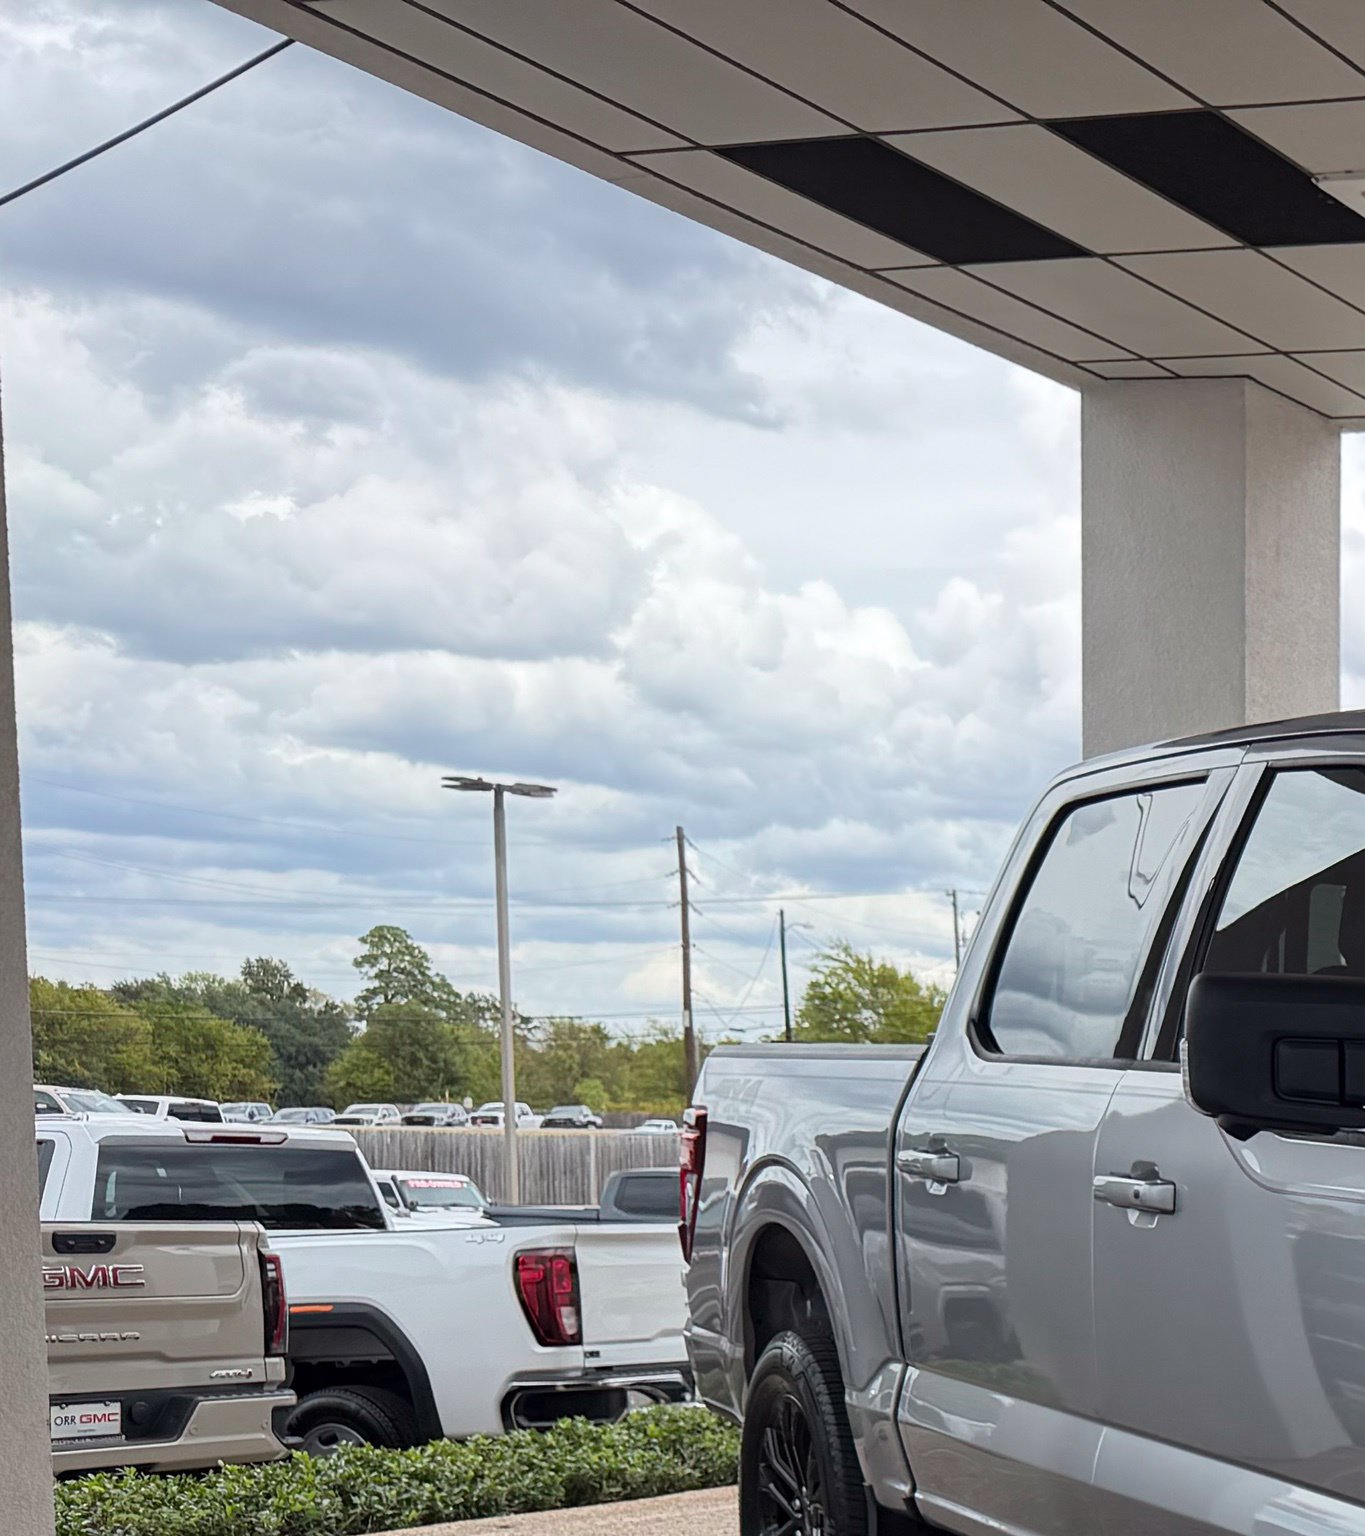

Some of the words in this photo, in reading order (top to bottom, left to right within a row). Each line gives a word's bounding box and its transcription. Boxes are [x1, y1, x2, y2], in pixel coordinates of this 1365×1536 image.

[42, 1263, 145, 1290] GMC
[54, 1414, 77, 1427] ORR
[79, 1412, 119, 1424] GMC
